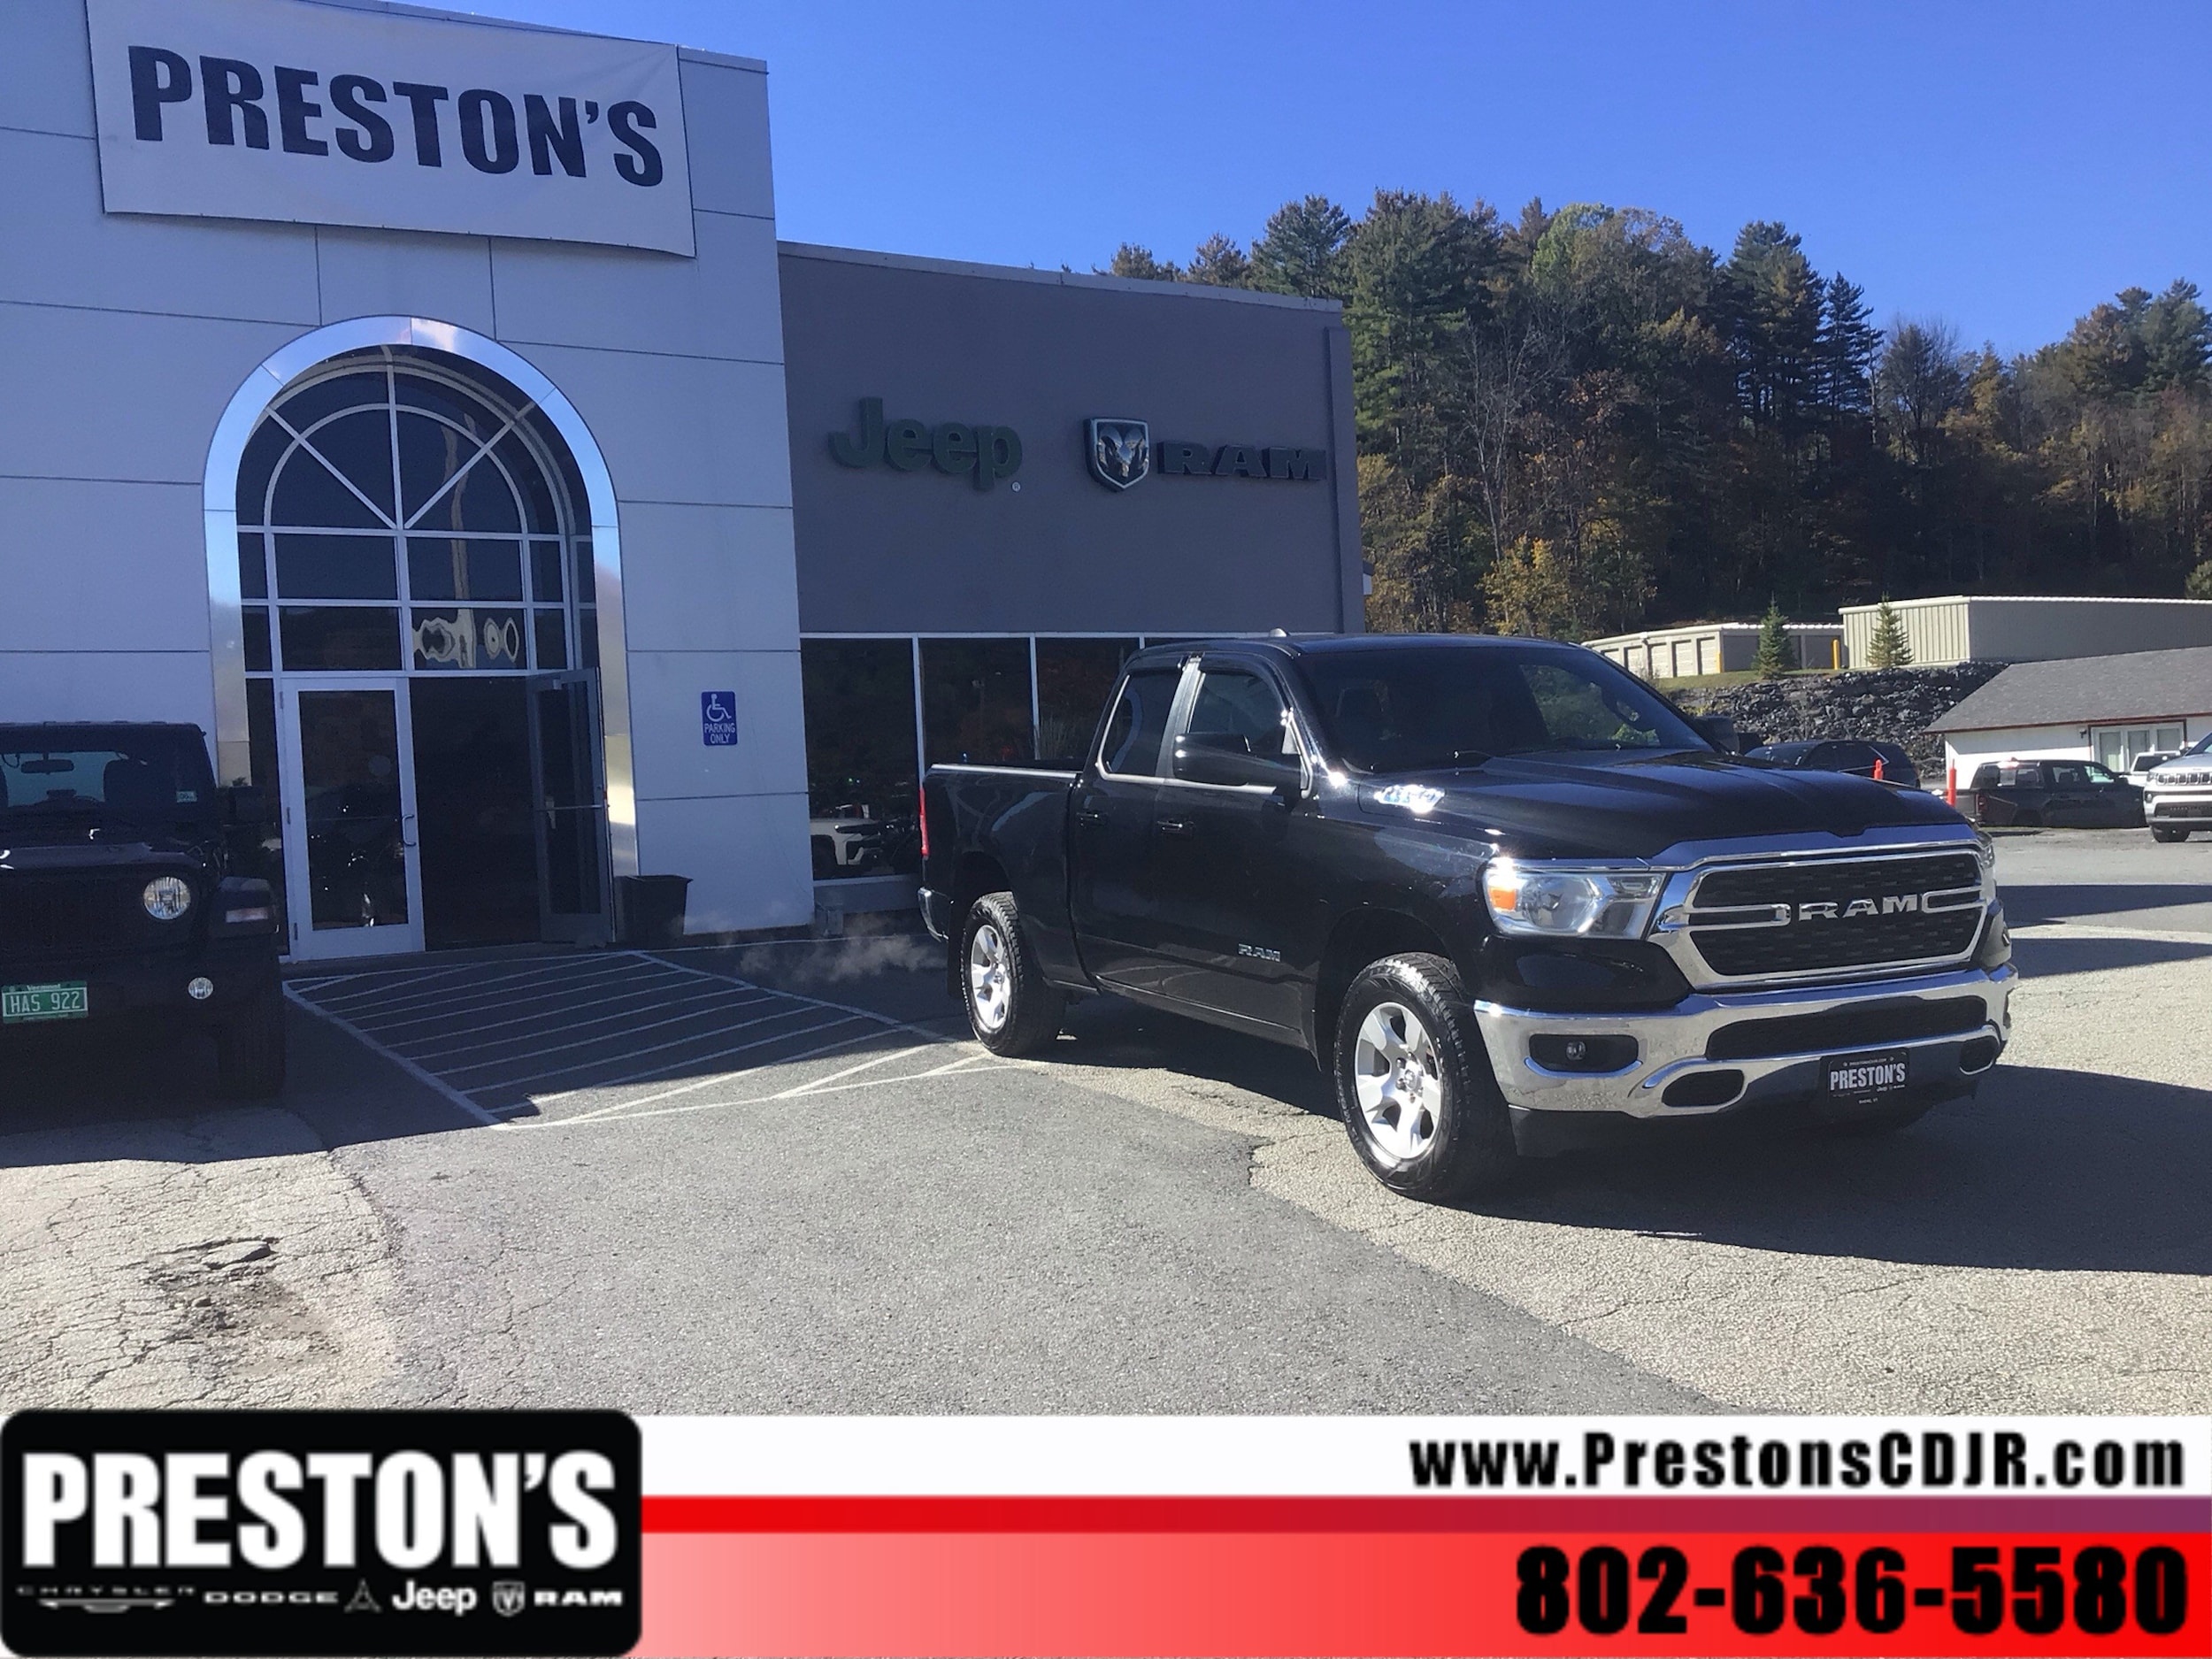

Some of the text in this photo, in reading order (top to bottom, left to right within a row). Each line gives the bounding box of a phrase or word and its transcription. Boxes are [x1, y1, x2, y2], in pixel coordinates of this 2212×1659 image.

[128, 45, 664, 188] PRESTON'S
[828, 397, 1023, 491] Jeep
[1158, 440, 1327, 480] RAM
[704, 722, 735, 733] PARKING
[710, 733, 730, 744] ONLY
[1798, 894, 1918, 921] RAM
[1238, 943, 1280, 963] RAM
[10, 991, 81, 1013] HAS 922
[1830, 1063, 1906, 1091] PRESTON'S
